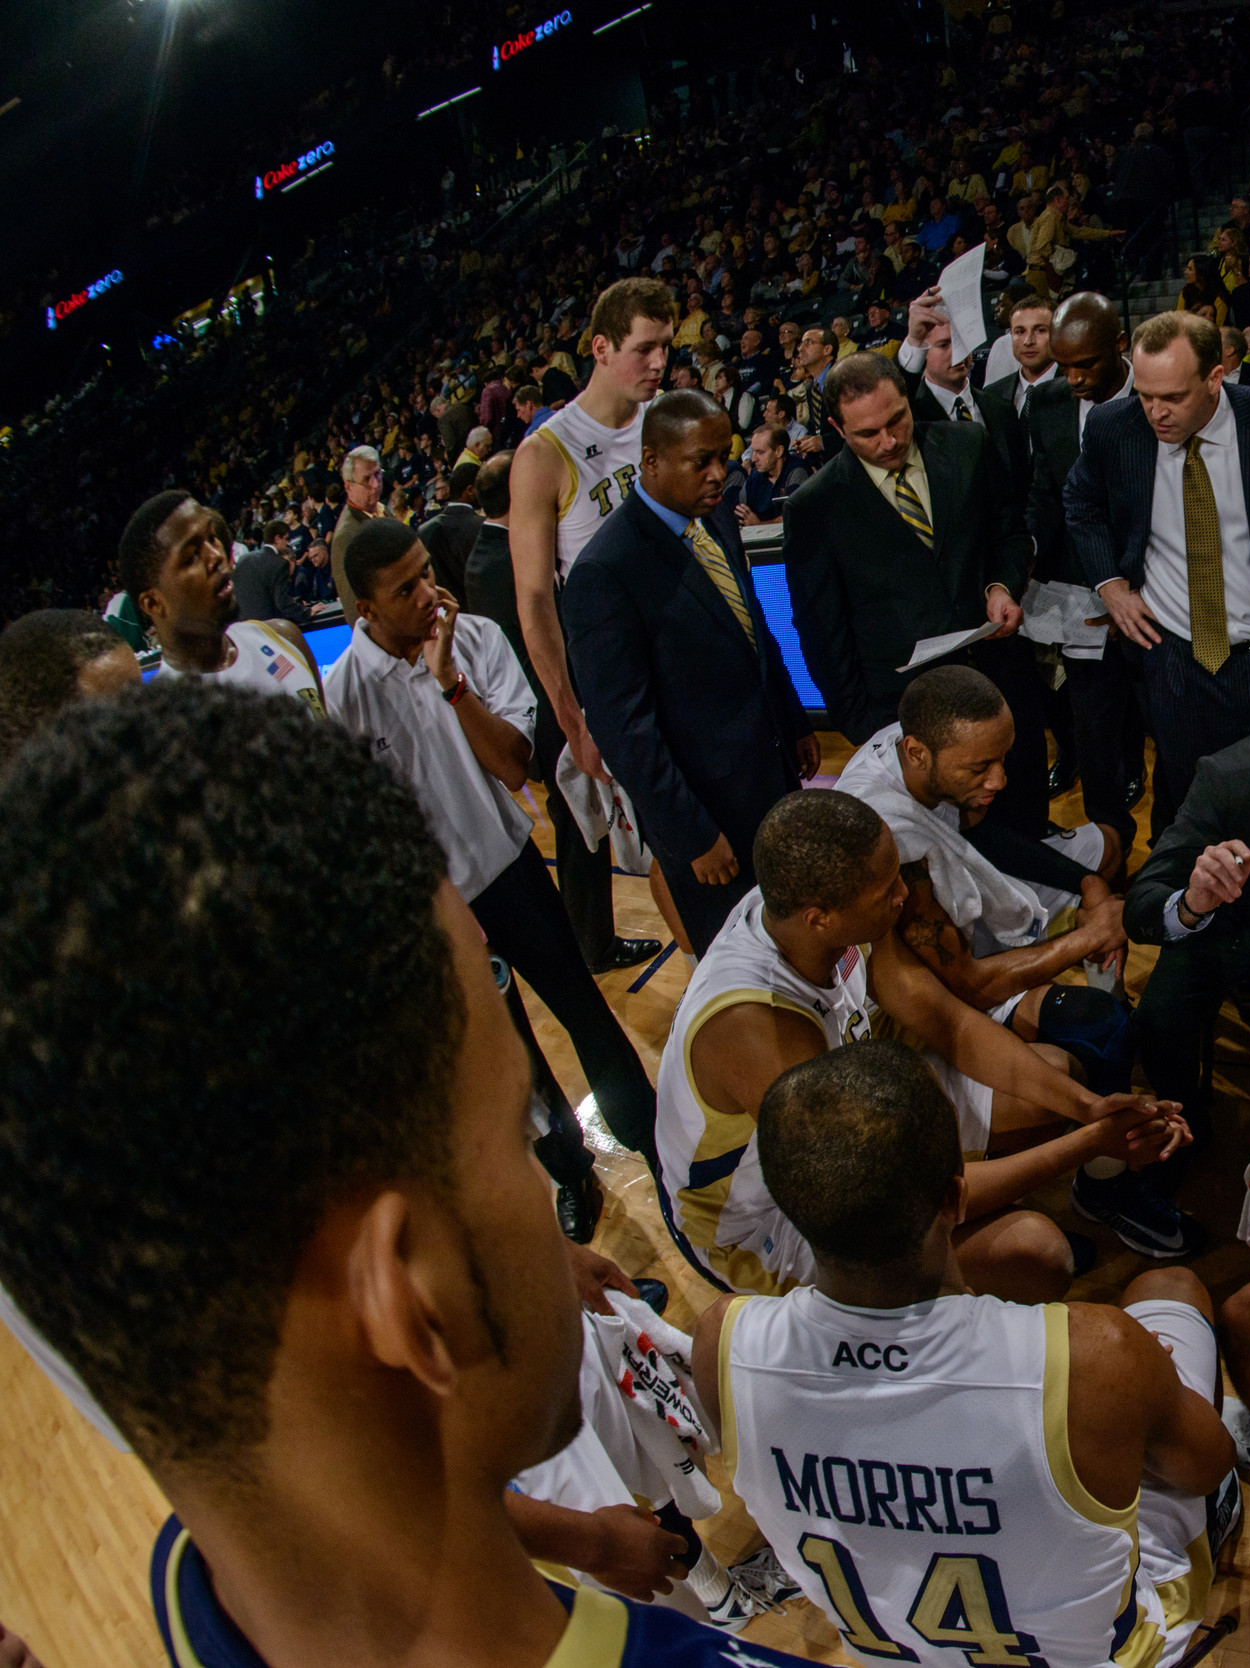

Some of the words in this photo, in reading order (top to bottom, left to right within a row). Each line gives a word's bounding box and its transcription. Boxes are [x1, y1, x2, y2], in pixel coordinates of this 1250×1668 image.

[832, 1340, 909, 1372] ACC
[771, 1446, 1001, 1535] MORRIS
[797, 1531, 1051, 1668] 14
